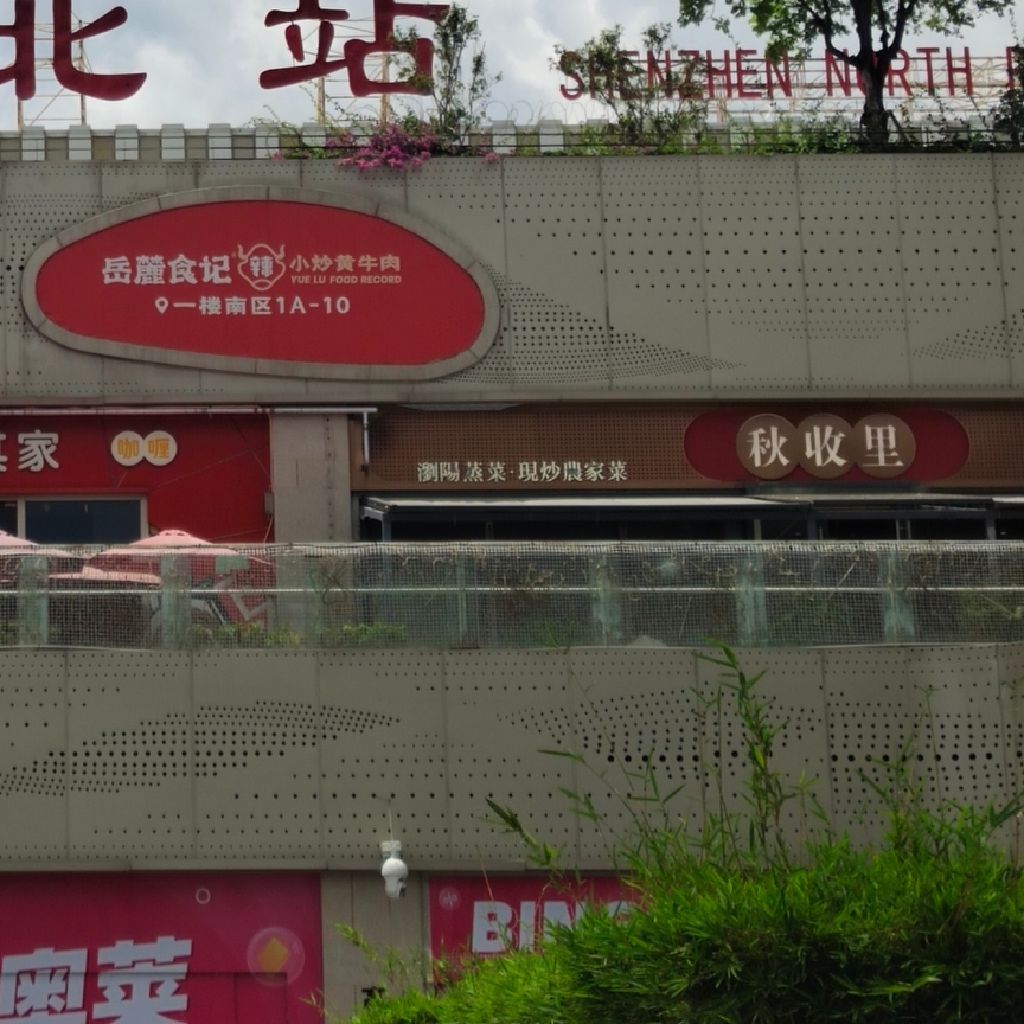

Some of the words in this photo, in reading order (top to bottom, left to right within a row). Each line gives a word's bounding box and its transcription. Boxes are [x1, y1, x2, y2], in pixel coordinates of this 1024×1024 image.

[824, 46, 973, 97] NRTH
[102, 254, 232, 284] 岳麓食记
[289, 254, 400, 272] 小炒黄牛肉
[291, 275, 310, 284] YUE
[313, 275, 326, 284] LU
[329, 275, 358, 284] FOOD
[360, 275, 402, 284] RECORD
[173, 295, 350, 315] 一楼南区1A-10
[118, 439, 169, 459] 咖喱
[746, 424, 904, 468] 秋收里
